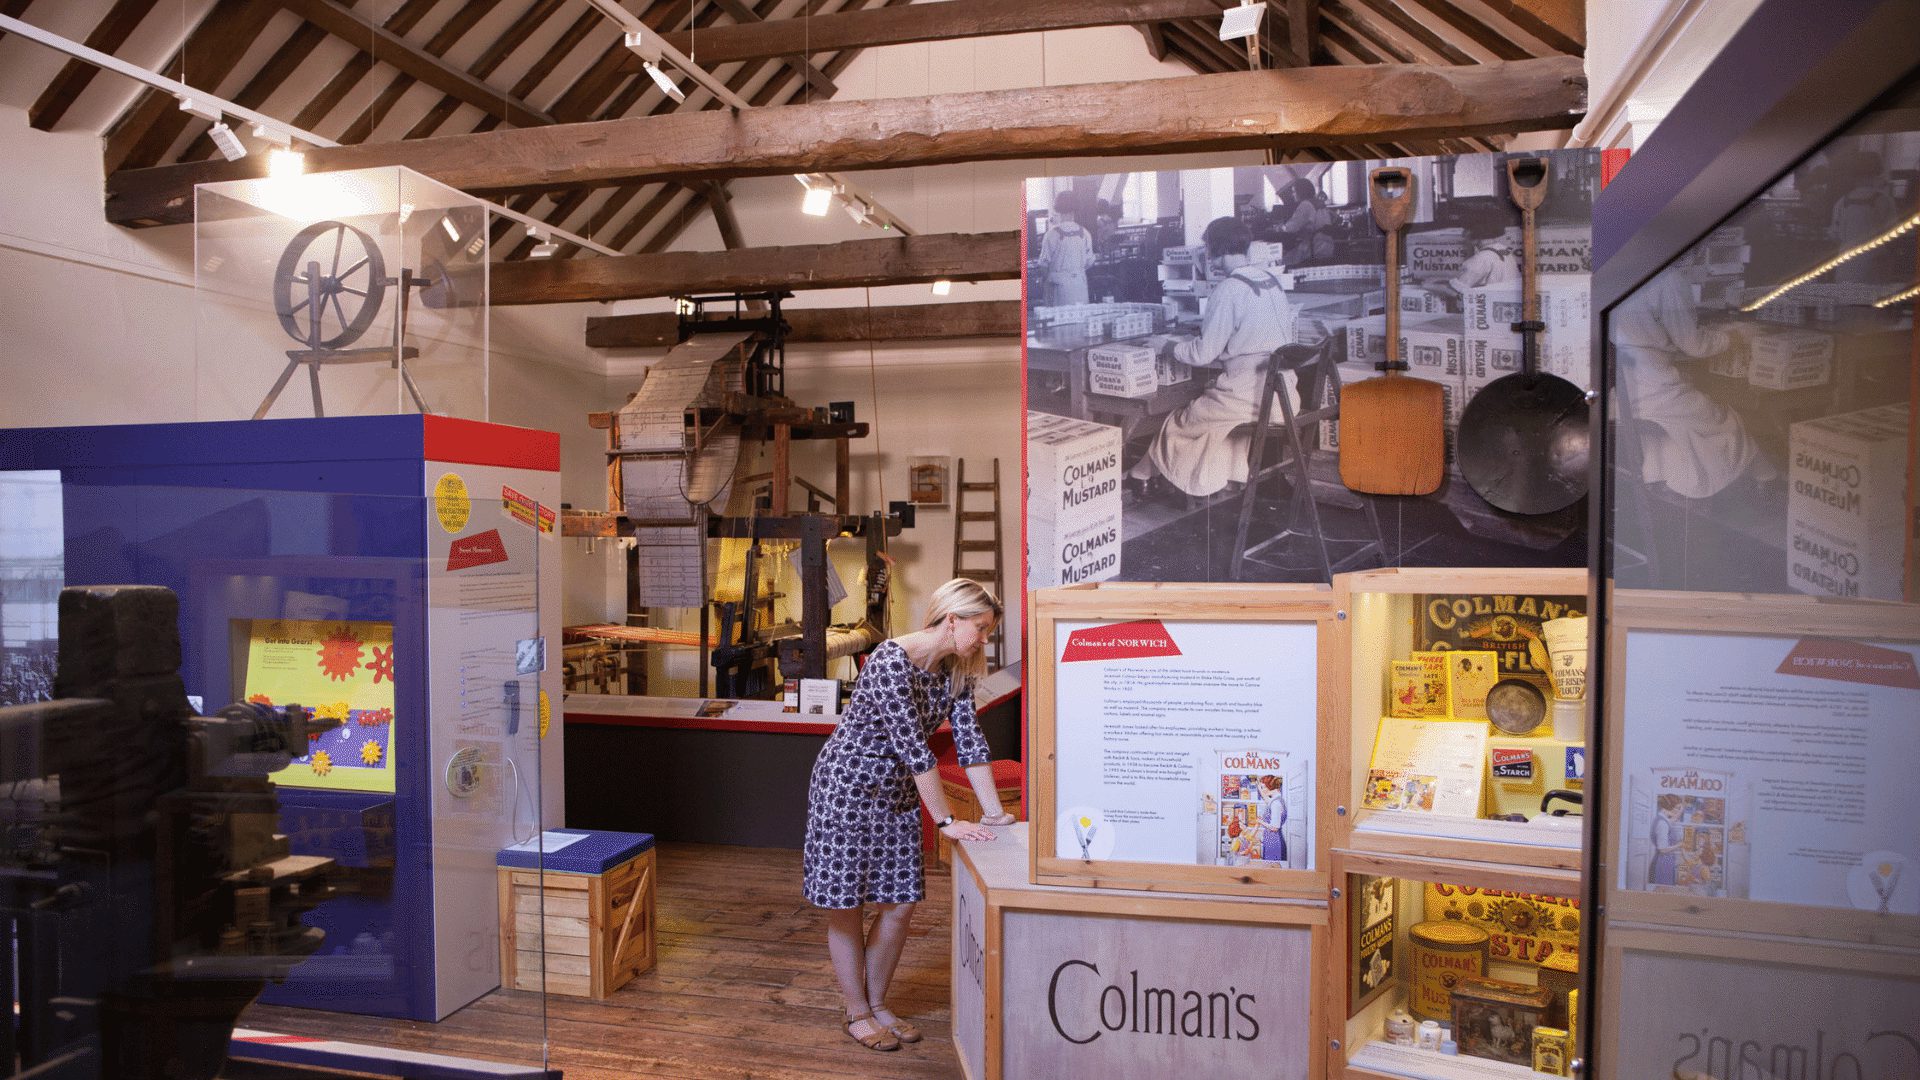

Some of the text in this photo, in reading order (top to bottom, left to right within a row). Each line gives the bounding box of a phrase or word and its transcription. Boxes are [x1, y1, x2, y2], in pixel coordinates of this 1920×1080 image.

[1414, 260, 1463, 271] MUSTAR
[1476, 293, 1489, 330] COLMAN'S
[1092, 353, 1118, 363] Colman's
[1446, 338, 1457, 375] MUSTARD
[1475, 340, 1487, 377] MUSTARD
[1095, 374, 1121, 384] Colman's
[1064, 451, 1116, 486] COLMAN'S
[1062, 478, 1116, 510] MUSTARD
[1062, 526, 1116, 564] COLMAN'S
[1062, 554, 1116, 585] MUSTARD
[1071, 638, 1167, 648] Colman's of NORWICH
[1224, 757, 1280, 770] COLMAN'S
[1494, 751, 1530, 763] COLMAN'S
[1500, 765, 1530, 776] STARCH
[1422, 953, 1477, 972] COLMAN'S
[1048, 959, 1260, 1044] Colman's
